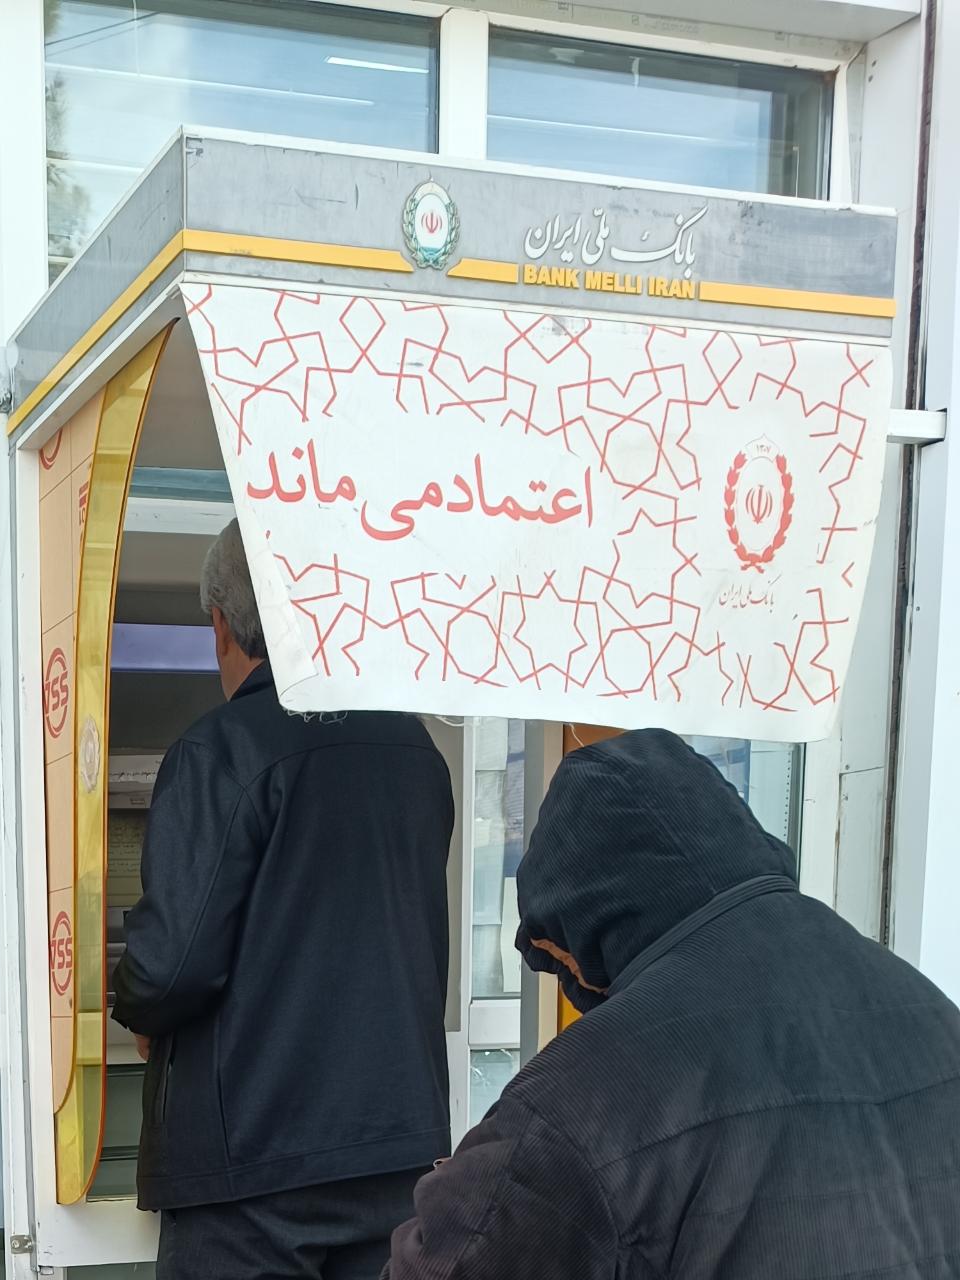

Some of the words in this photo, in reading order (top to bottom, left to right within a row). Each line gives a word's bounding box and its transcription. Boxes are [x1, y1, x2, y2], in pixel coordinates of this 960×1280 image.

[524, 213, 582, 262] ایران
[610, 205, 709, 279] بانک
[523, 264, 580, 289] BANK
[585, 270, 643, 295] MELLI
[648, 276, 696, 299] IRAN
